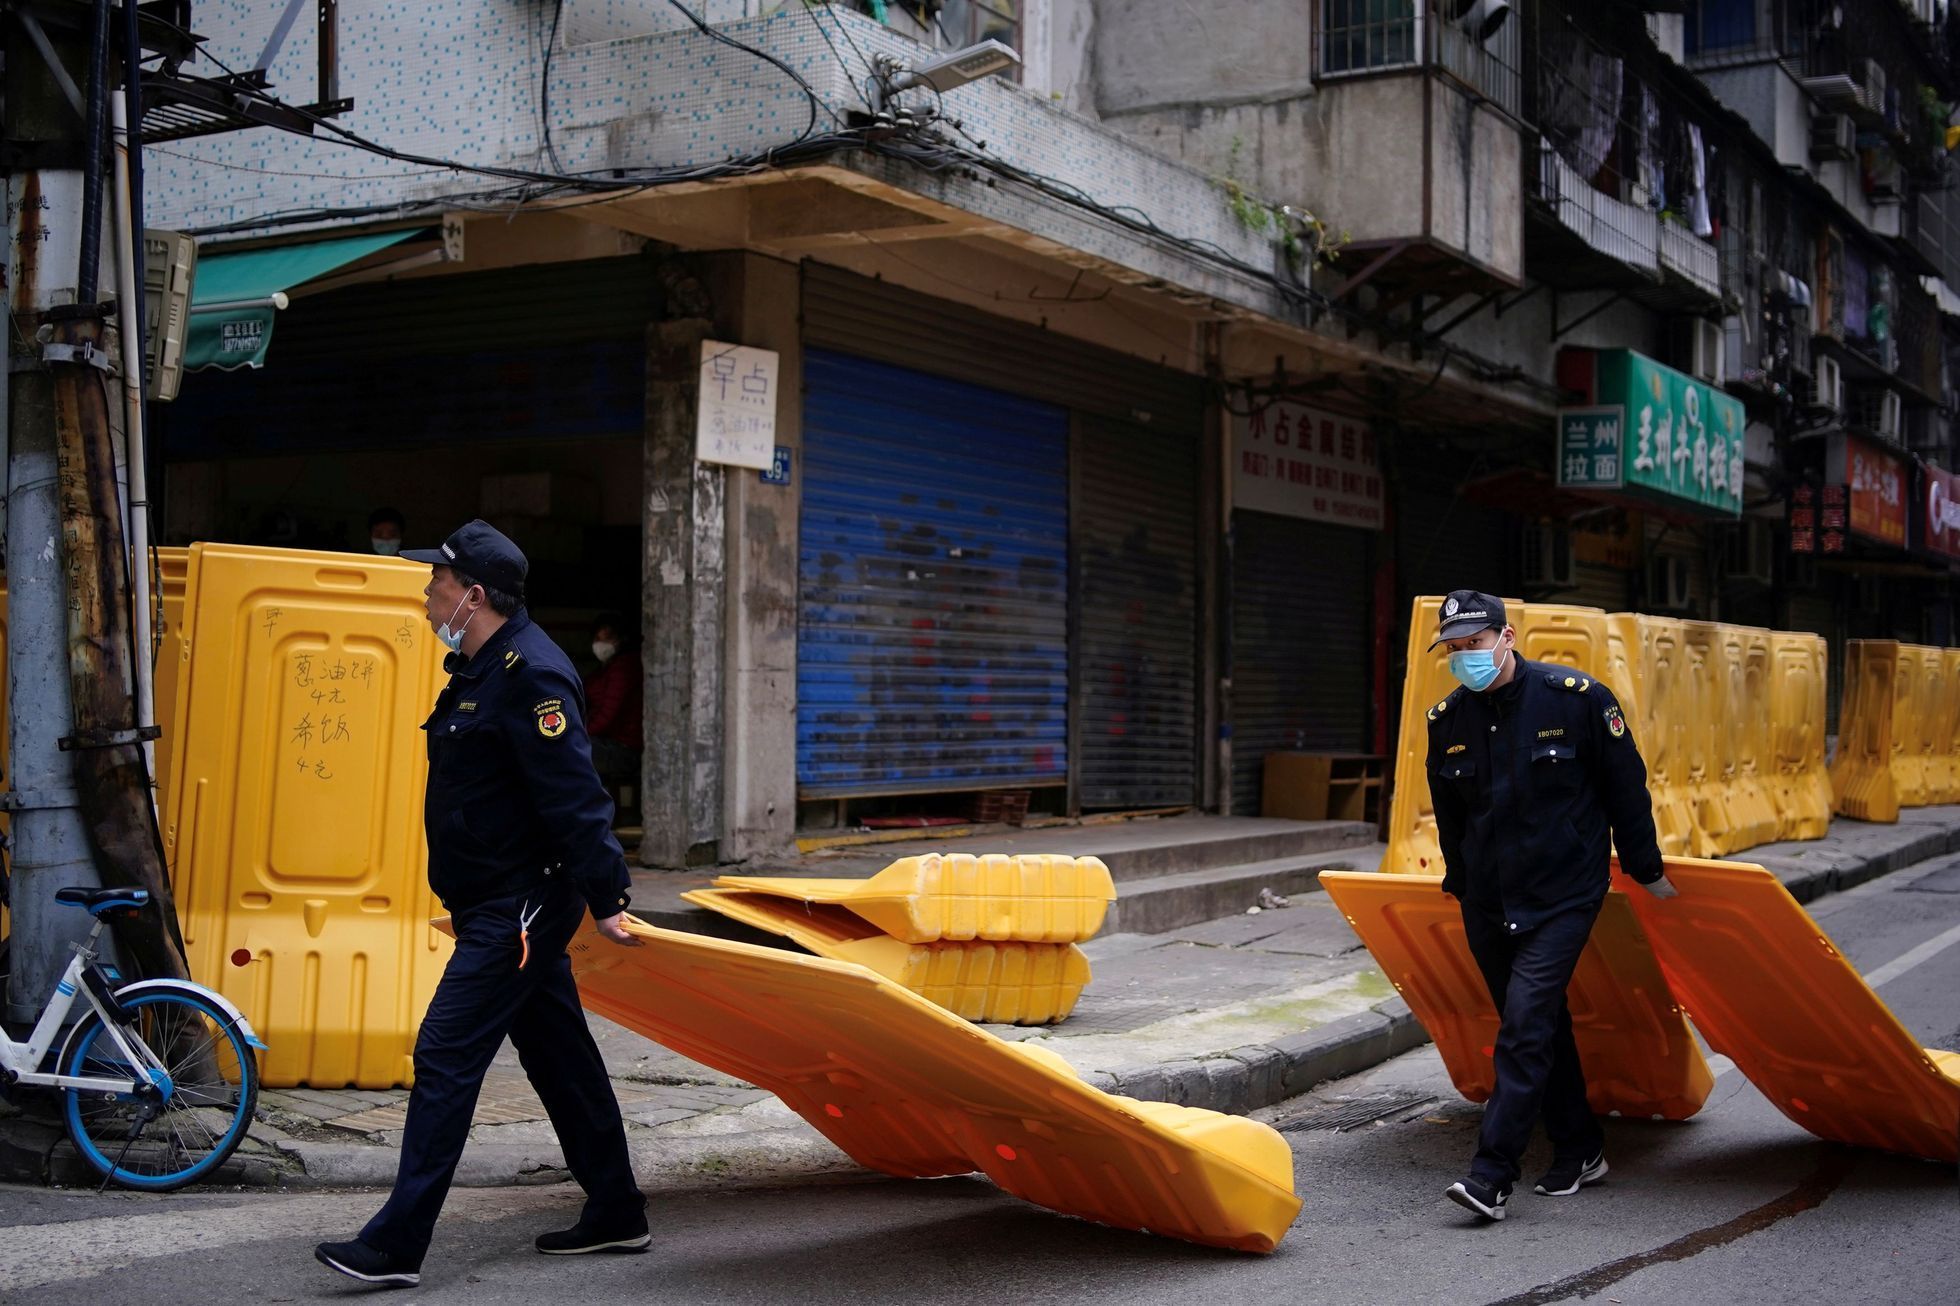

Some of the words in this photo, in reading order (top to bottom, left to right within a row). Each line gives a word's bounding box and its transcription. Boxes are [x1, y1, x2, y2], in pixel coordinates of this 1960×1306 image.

[712, 353, 768, 406] 早点
[1566, 419, 1618, 449] 兰州
[1566, 453, 1618, 482] 拉面
